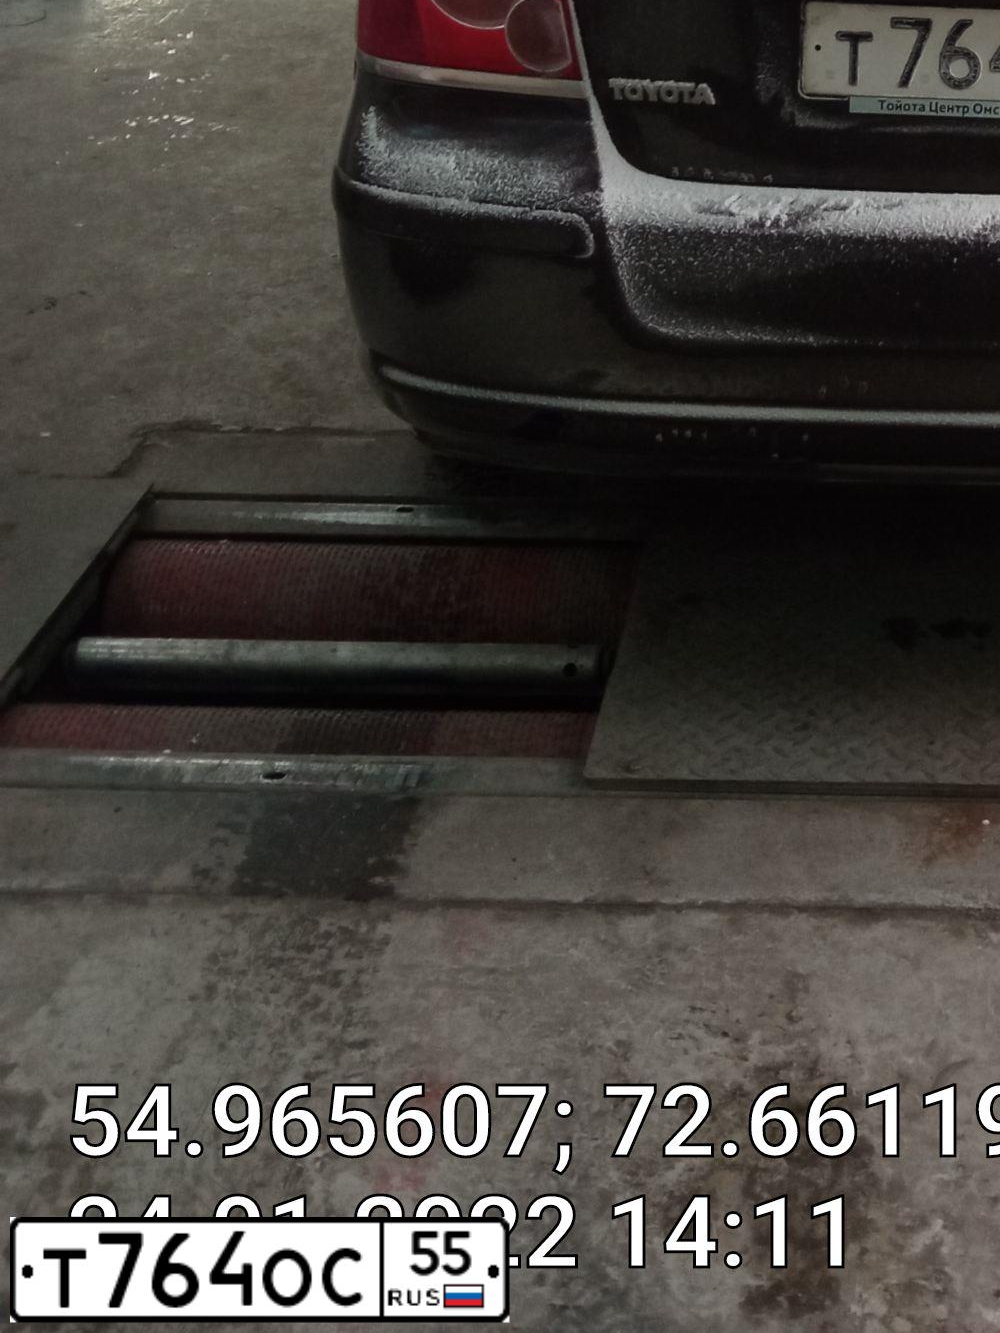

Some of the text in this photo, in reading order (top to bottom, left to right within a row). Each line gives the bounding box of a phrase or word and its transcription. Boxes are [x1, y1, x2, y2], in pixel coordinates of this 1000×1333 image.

[608, 77, 716, 105] TOYOTA
[877, 99, 925, 114] Тойота
[928, 100, 969, 117] Центр
